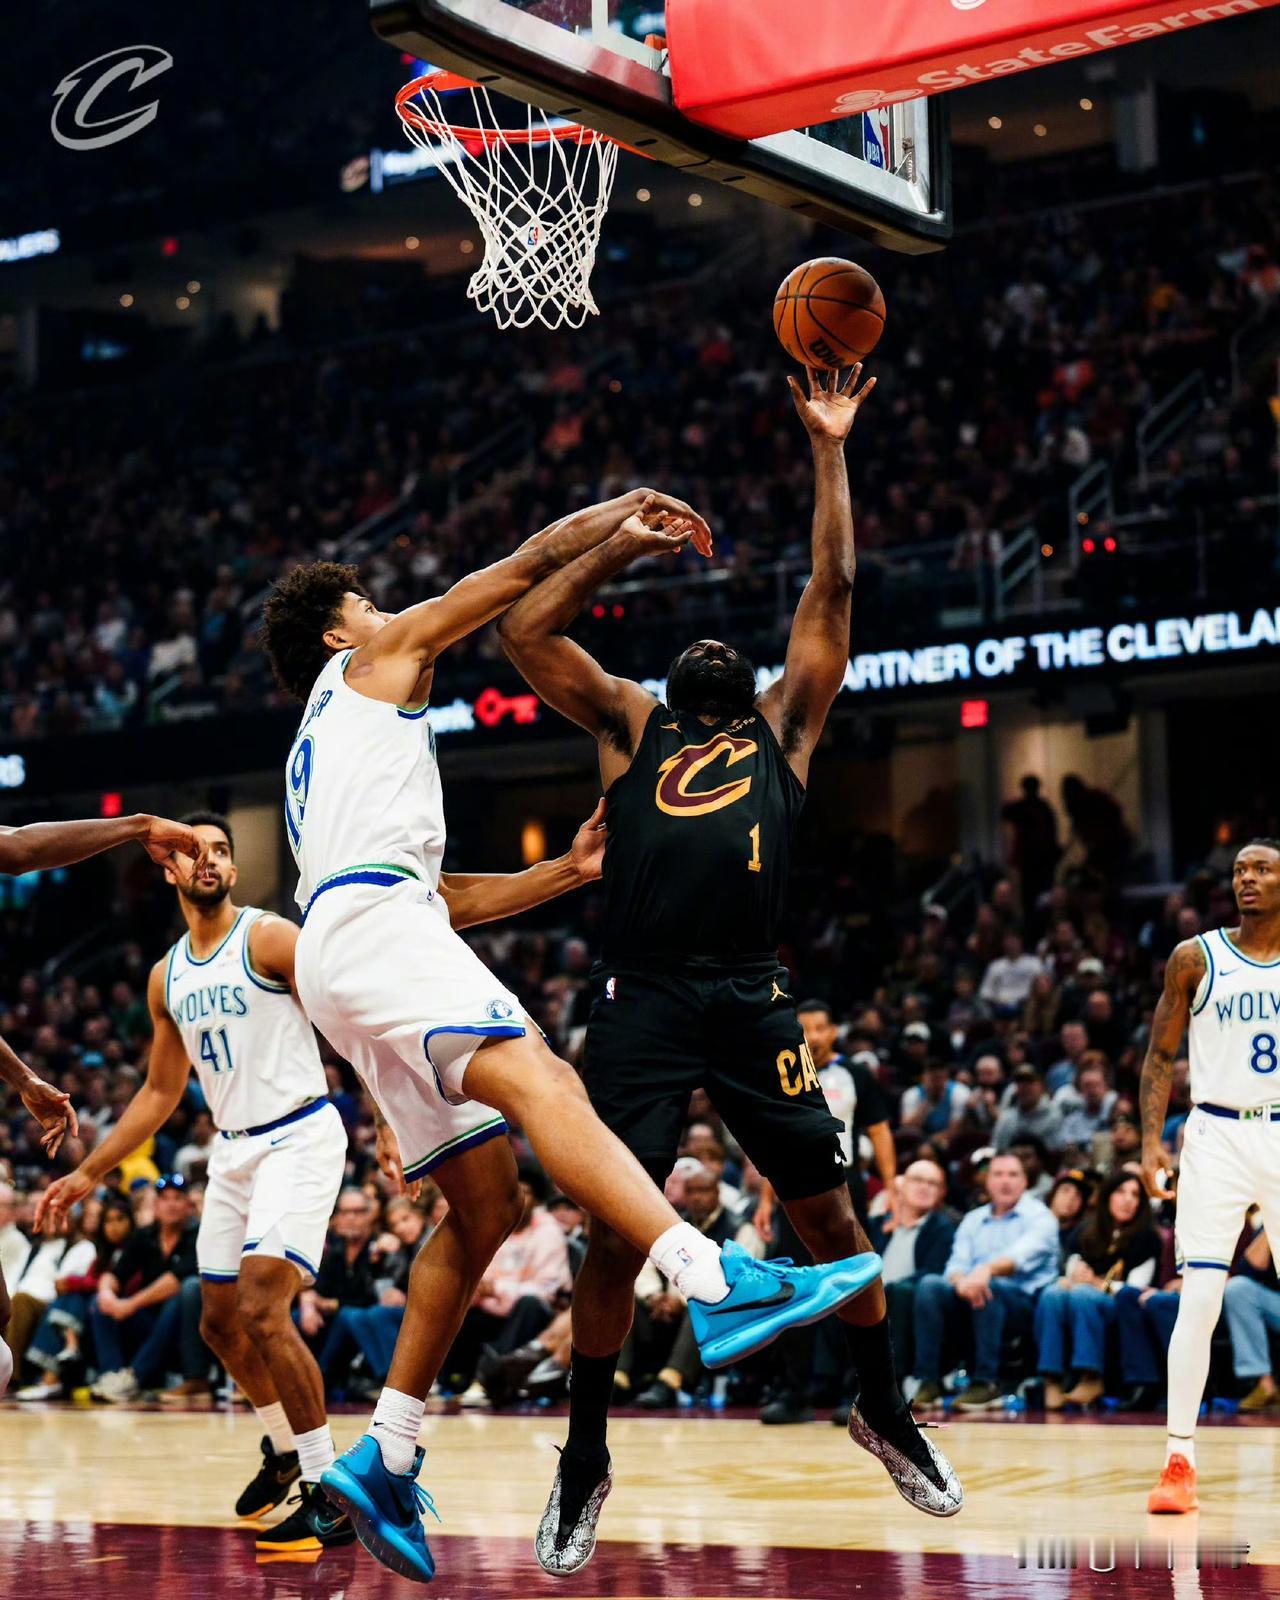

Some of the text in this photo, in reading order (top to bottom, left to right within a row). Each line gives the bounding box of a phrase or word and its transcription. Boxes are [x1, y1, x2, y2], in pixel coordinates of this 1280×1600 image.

[974, 636, 1027, 677] OF
[1029, 626, 1105, 671] THE
[1106, 606, 1280, 663] CLEVELA
[655, 732, 759, 818] C
[747, 822, 762, 873] 1
[172, 984, 249, 1025] WOLVES
[198, 1024, 237, 1074] 41
[1248, 1030, 1280, 1076] 8
